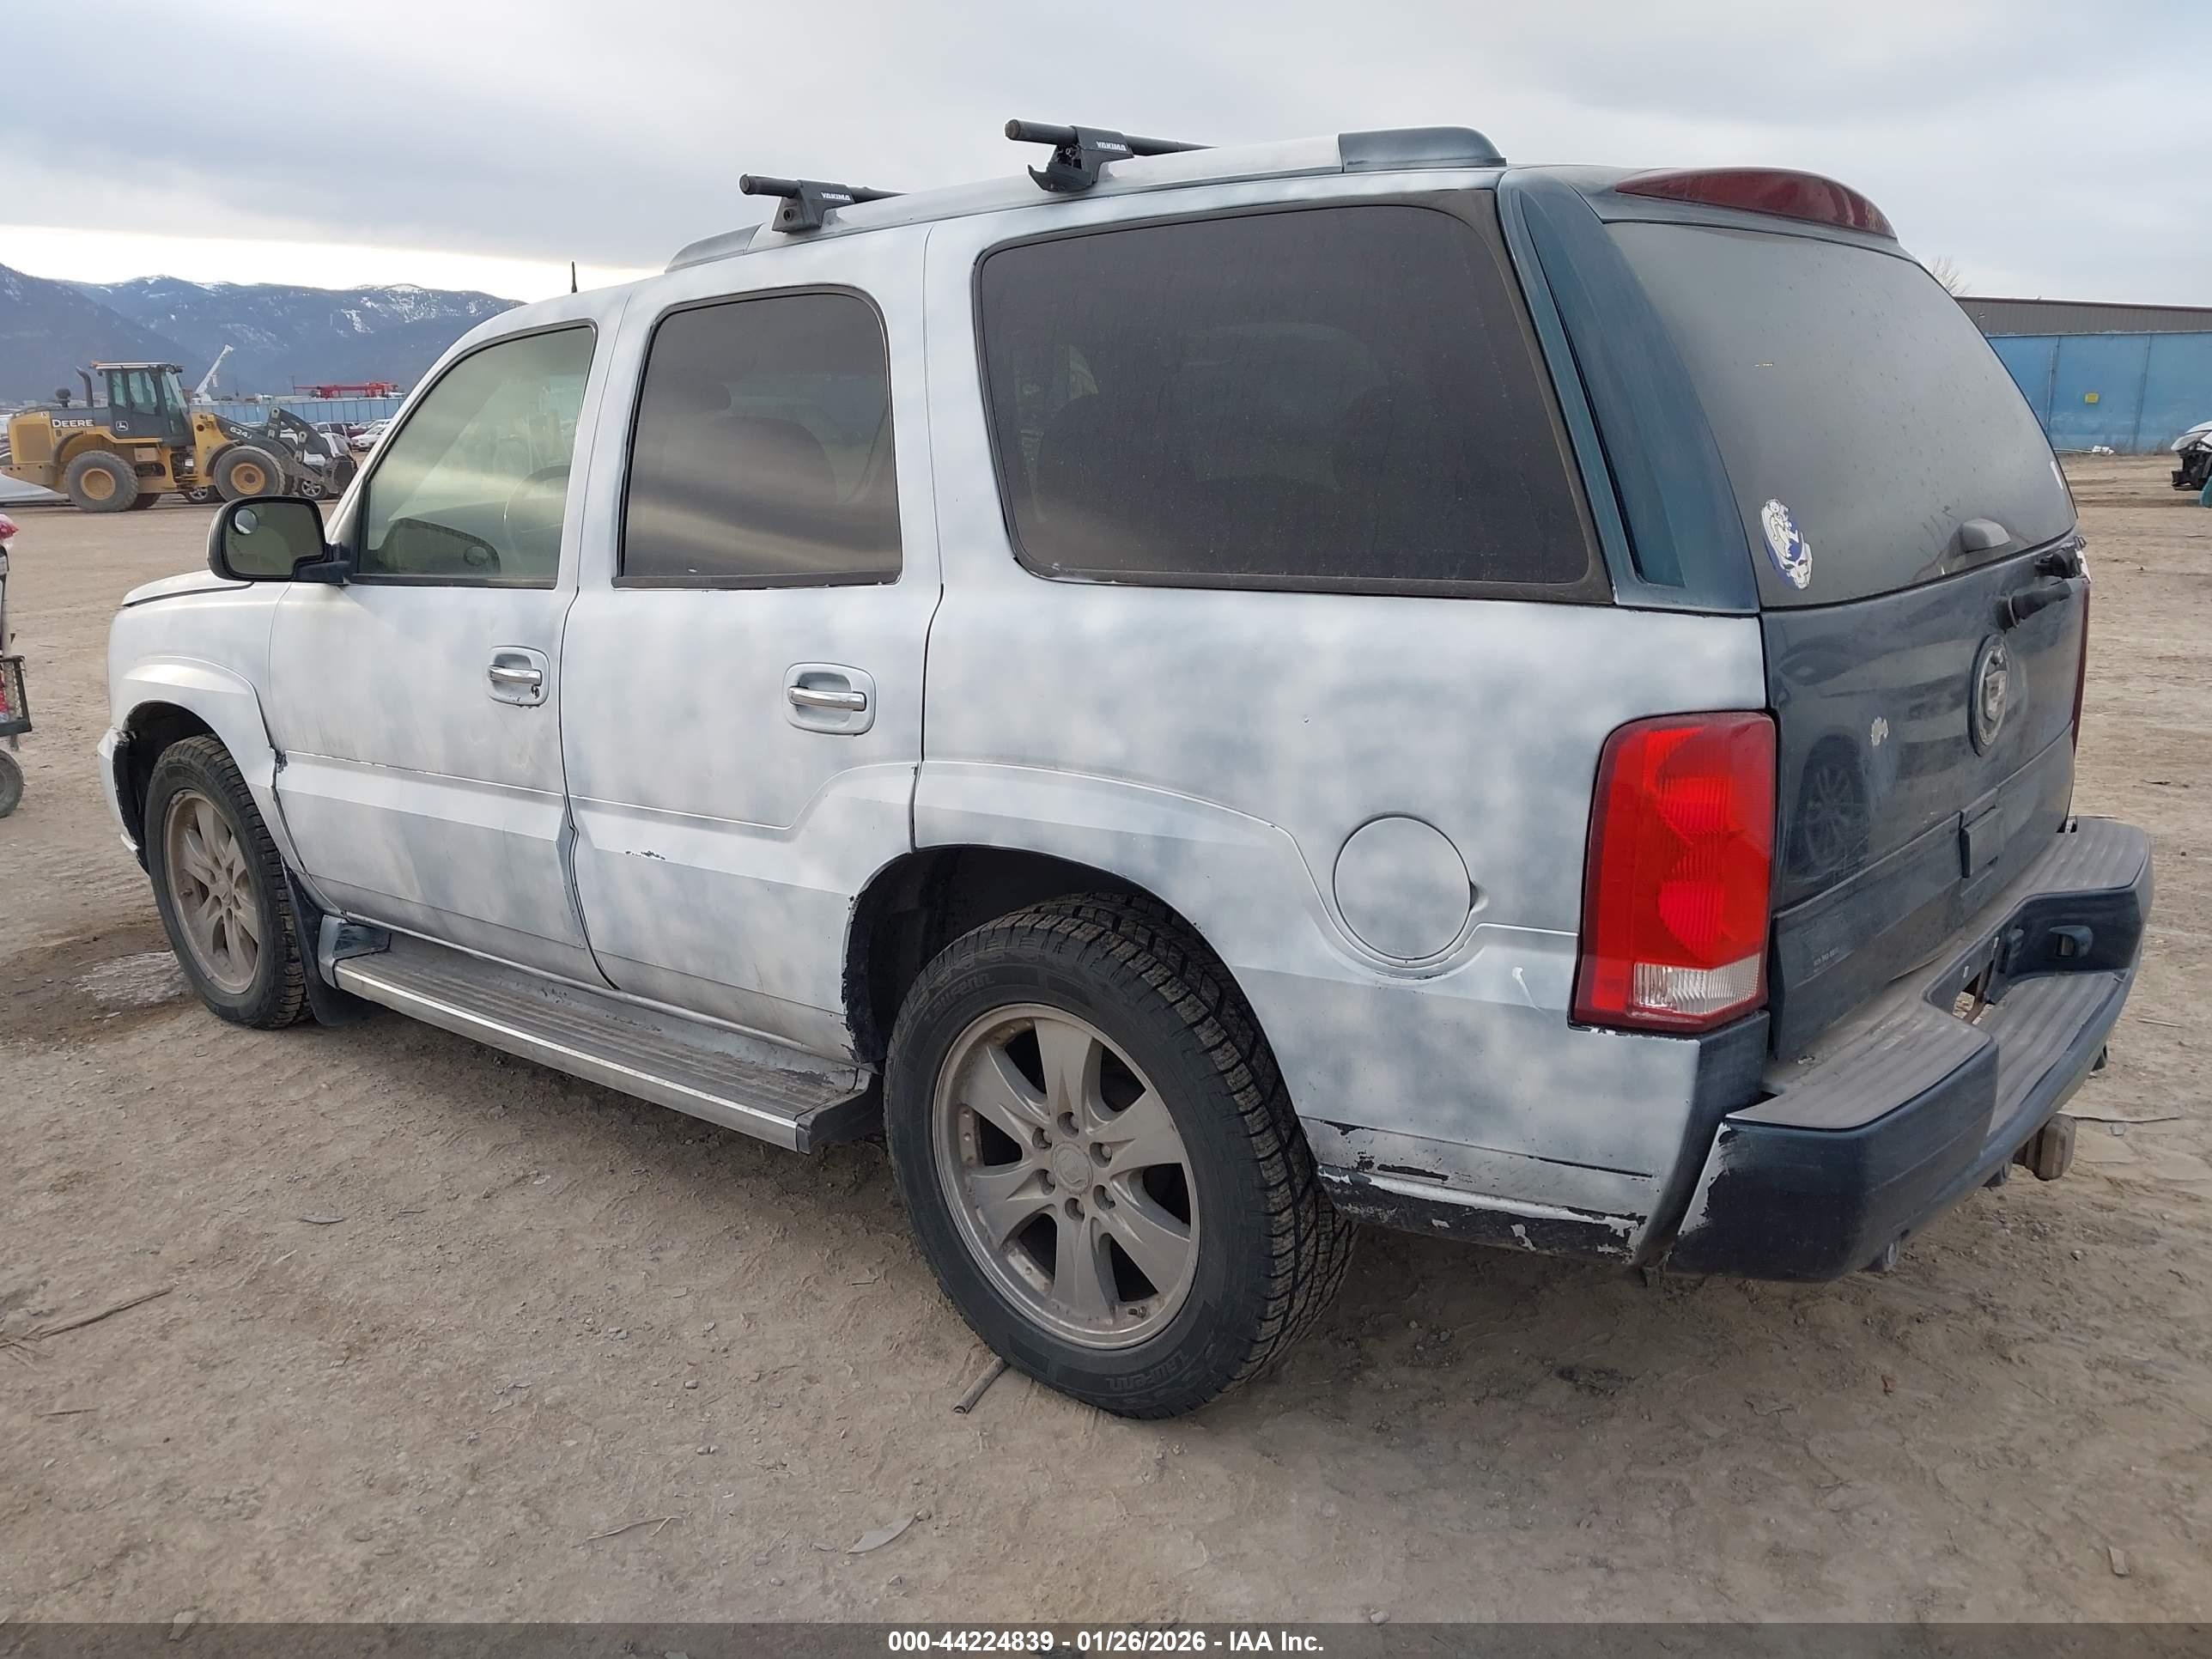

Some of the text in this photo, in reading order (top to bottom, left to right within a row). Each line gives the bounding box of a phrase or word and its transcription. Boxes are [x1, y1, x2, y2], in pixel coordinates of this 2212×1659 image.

[1096, 141, 1127, 151] YAKIMA
[820, 191, 851, 201] YAKIMA
[52, 419, 94, 428] DEERE
[229, 426, 252, 440] 624J
